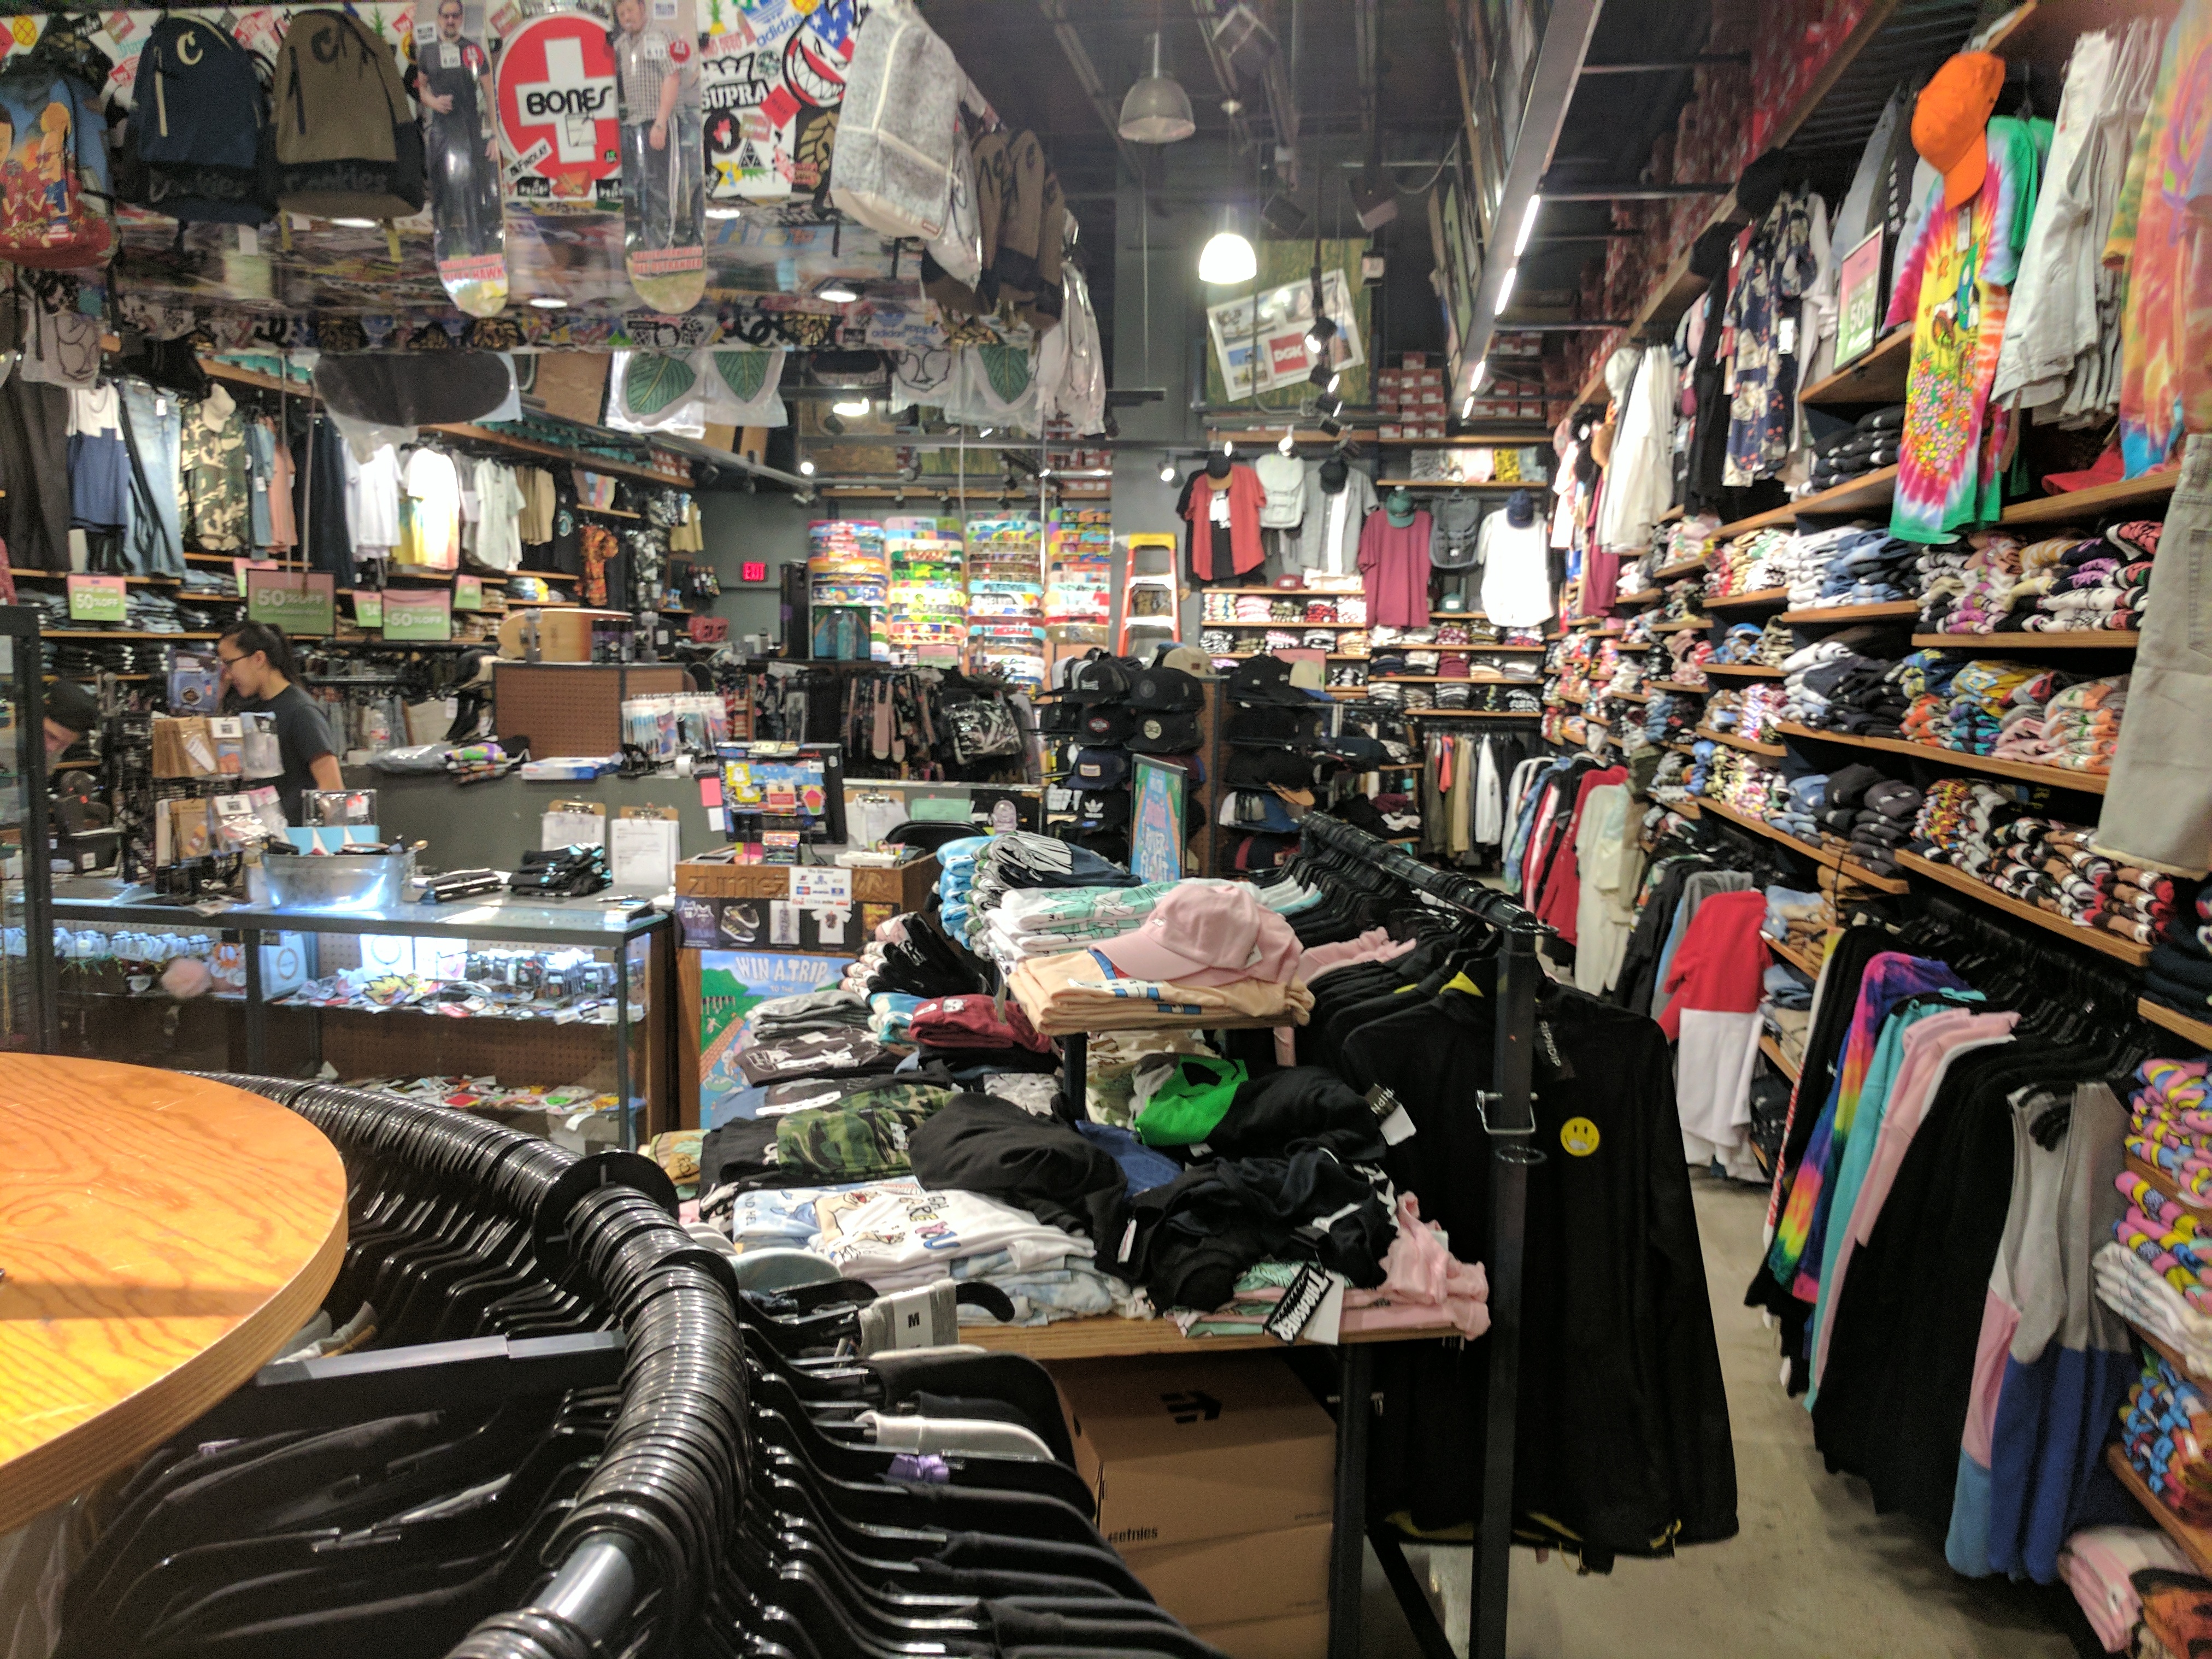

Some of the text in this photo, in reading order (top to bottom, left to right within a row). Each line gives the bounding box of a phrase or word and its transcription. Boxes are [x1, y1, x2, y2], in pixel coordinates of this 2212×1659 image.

[757, 14, 803, 47] adidas
[526, 85, 613, 116] BONES
[702, 81, 768, 109] SUPRA
[1274, 345, 1304, 362] DGK
[744, 563, 764, 580] EXIT
[736, 957, 829, 984] WIN A TRIP
[1539, 1020, 1562, 1067] RIPNDIP
[1270, 1268, 1329, 1341] THRASHER
[908, 1312, 920, 1328] M
